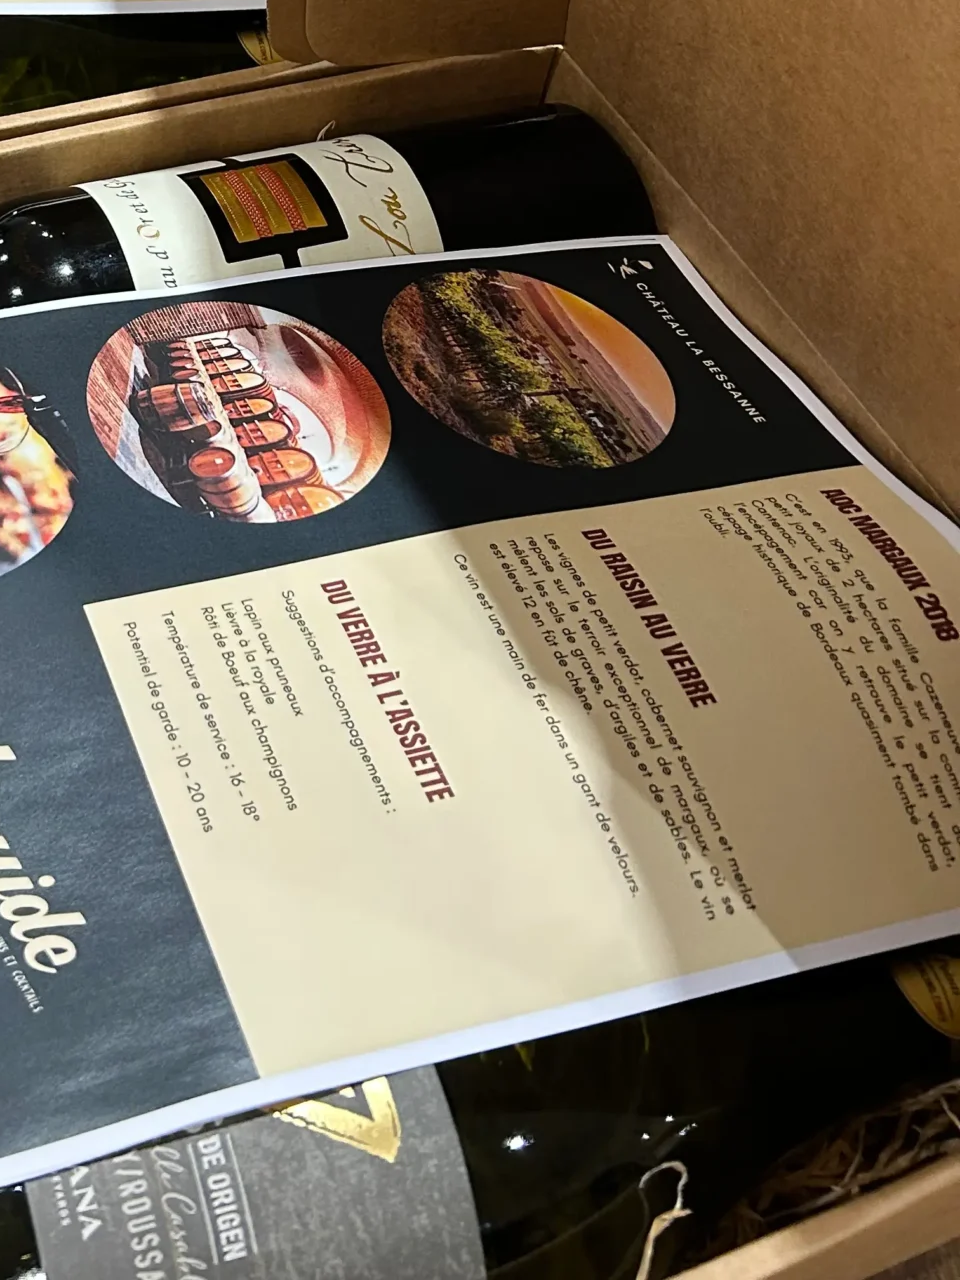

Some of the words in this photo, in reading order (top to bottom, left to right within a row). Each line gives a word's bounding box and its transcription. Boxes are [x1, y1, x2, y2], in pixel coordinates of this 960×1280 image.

[636, 282, 689, 337] CHÂTEAU
[685, 341, 704, 356] LA
[702, 359, 766, 423] BESSANNE
[543, 533, 561, 551] Les
[699, 507, 730, 538] l'oubli.
[557, 552, 586, 588] vignes
[819, 488, 863, 515] AOC
[847, 514, 931, 592] MARGAUX
[913, 592, 960, 642] 2018
[240, 598, 263, 630] Lapin
[320, 579, 356, 605] DU
[582, 589, 597, 606] de
[220, 602, 243, 636] Lièvre
[336, 606, 388, 668] VERRE
[489, 543, 507, 559] est
[501, 562, 529, 593] élevé
[521, 594, 538, 609] 12
[530, 611, 545, 628] en
[541, 629, 559, 647] fût
[553, 650, 569, 668] de
[564, 670, 593, 715] chêne.
[581, 528, 617, 551] DU
[599, 552, 659, 610] RAISIN
[640, 613, 677, 640] AU
[660, 641, 718, 708] VERRE
[589, 608, 618, 637] petit
[123, 621, 157, 678] Potentiel
[238, 639, 251, 648] à
[243, 649, 257, 663] la
[257, 632, 275, 655] aux
[613, 639, 644, 686] verdot,
[146, 680, 162, 698] de
[161, 610, 201, 689] Température
[195, 692, 212, 710] de
[204, 713, 230, 760] service
[229, 771, 246, 787] 16
[250, 665, 277, 705] royale
[265, 657, 303, 717] pruneaux
[281, 589, 324, 662] Suggestions
[318, 663, 392, 806] d'accompagnements
[367, 670, 401, 688] À
[716, 505, 753, 541] cépage
[751, 543, 798, 597] historique
[796, 601, 812, 618] de
[809, 622, 853, 687] Bordeaux
[850, 691, 897, 769] quasiment
[891, 774, 922, 826] tombé
[916, 832, 939, 872] dans
[733, 502, 808, 581] l'encépagement
[808, 589, 828, 610] car
[828, 619, 844, 637] on
[840, 646, 856, 655] y
[855, 664, 893, 724] retrouve
[892, 735, 906, 750] le
[901, 762, 929, 799] petit
[927, 811, 957, 868] verdot,
[150, 701, 179, 742] garde
[200, 606, 220, 630] Rôti
[212, 632, 228, 648] de
[221, 650, 251, 687] Boeuf
[239, 691, 257, 716] aux
[251, 718, 298, 811] champignons
[453, 553, 468, 571] Ce
[464, 573, 480, 590] vin
[476, 592, 494, 611] est
[487, 613, 506, 637] une
[502, 639, 525, 671] main
[521, 673, 537, 690] de
[532, 693, 550, 712] fer
[545, 715, 569, 750] dans
[564, 752, 579, 770] un
[572, 773, 601, 808] gant
[595, 812, 611, 833] de
[607, 836, 639, 898] velours.
[506, 539, 538, 577] mêlent
[532, 579, 549, 598] les
[545, 600, 566, 624] sols
[561, 627, 577, 644] de
[570, 648, 604, 695] graves,
[602, 698, 641, 758] d'argiles
[637, 762, 654, 778] et
[648, 783, 665, 804] de
[660, 809, 691, 864] sables.
[689, 870, 704, 890] Le
[701, 895, 716, 921] vin
[525, 536, 555, 573] repose
[552, 578, 570, 596] sur
[567, 600, 581, 613] le
[577, 618, 606, 656] terroir
[604, 662, 663, 750] exceptionnel
[656, 756, 673, 776] de
[670, 784, 711, 857] margaux,
[709, 865, 726, 888] où
[721, 895, 735, 916] se
[640, 688, 684, 751] cabernet
[175, 752, 192, 768] 10
[376, 689, 455, 803] L'ASSIETTE
[186, 782, 206, 803] 20
[677, 755, 722, 832] sauvignon
[195, 807, 213, 833] ans
[718, 835, 734, 852] et
[727, 857, 757, 911] merlot
[196, 1133, 227, 1170] DE
[206, 1172, 248, 1262] ORIGEN
